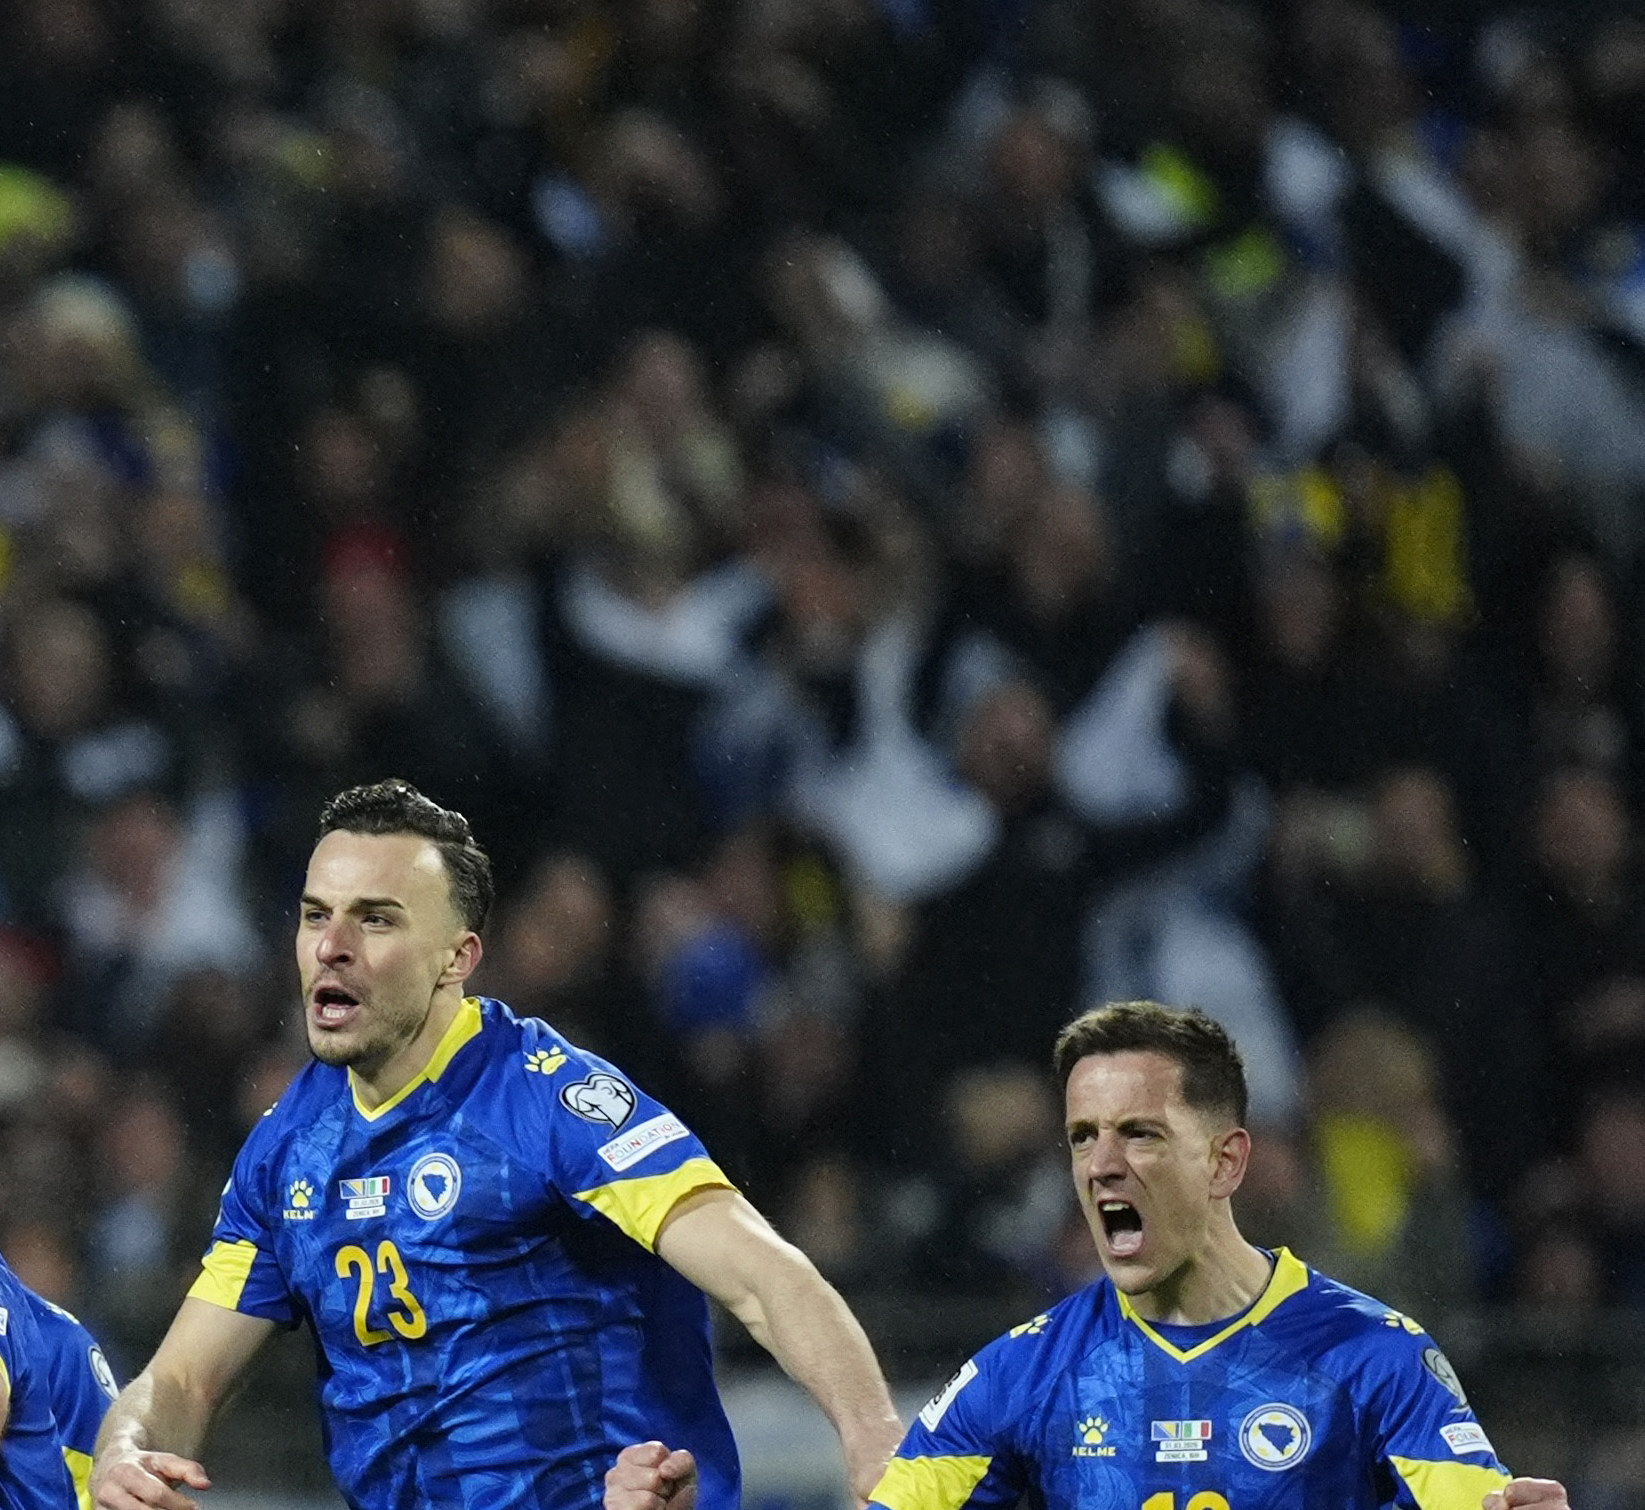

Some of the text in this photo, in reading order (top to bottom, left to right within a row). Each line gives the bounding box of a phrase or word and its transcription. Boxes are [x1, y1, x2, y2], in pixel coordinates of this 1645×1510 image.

[606, 1121, 681, 1163] FOUNDATION
[282, 1208, 314, 1220] KELM
[335, 1239, 428, 1347] 23
